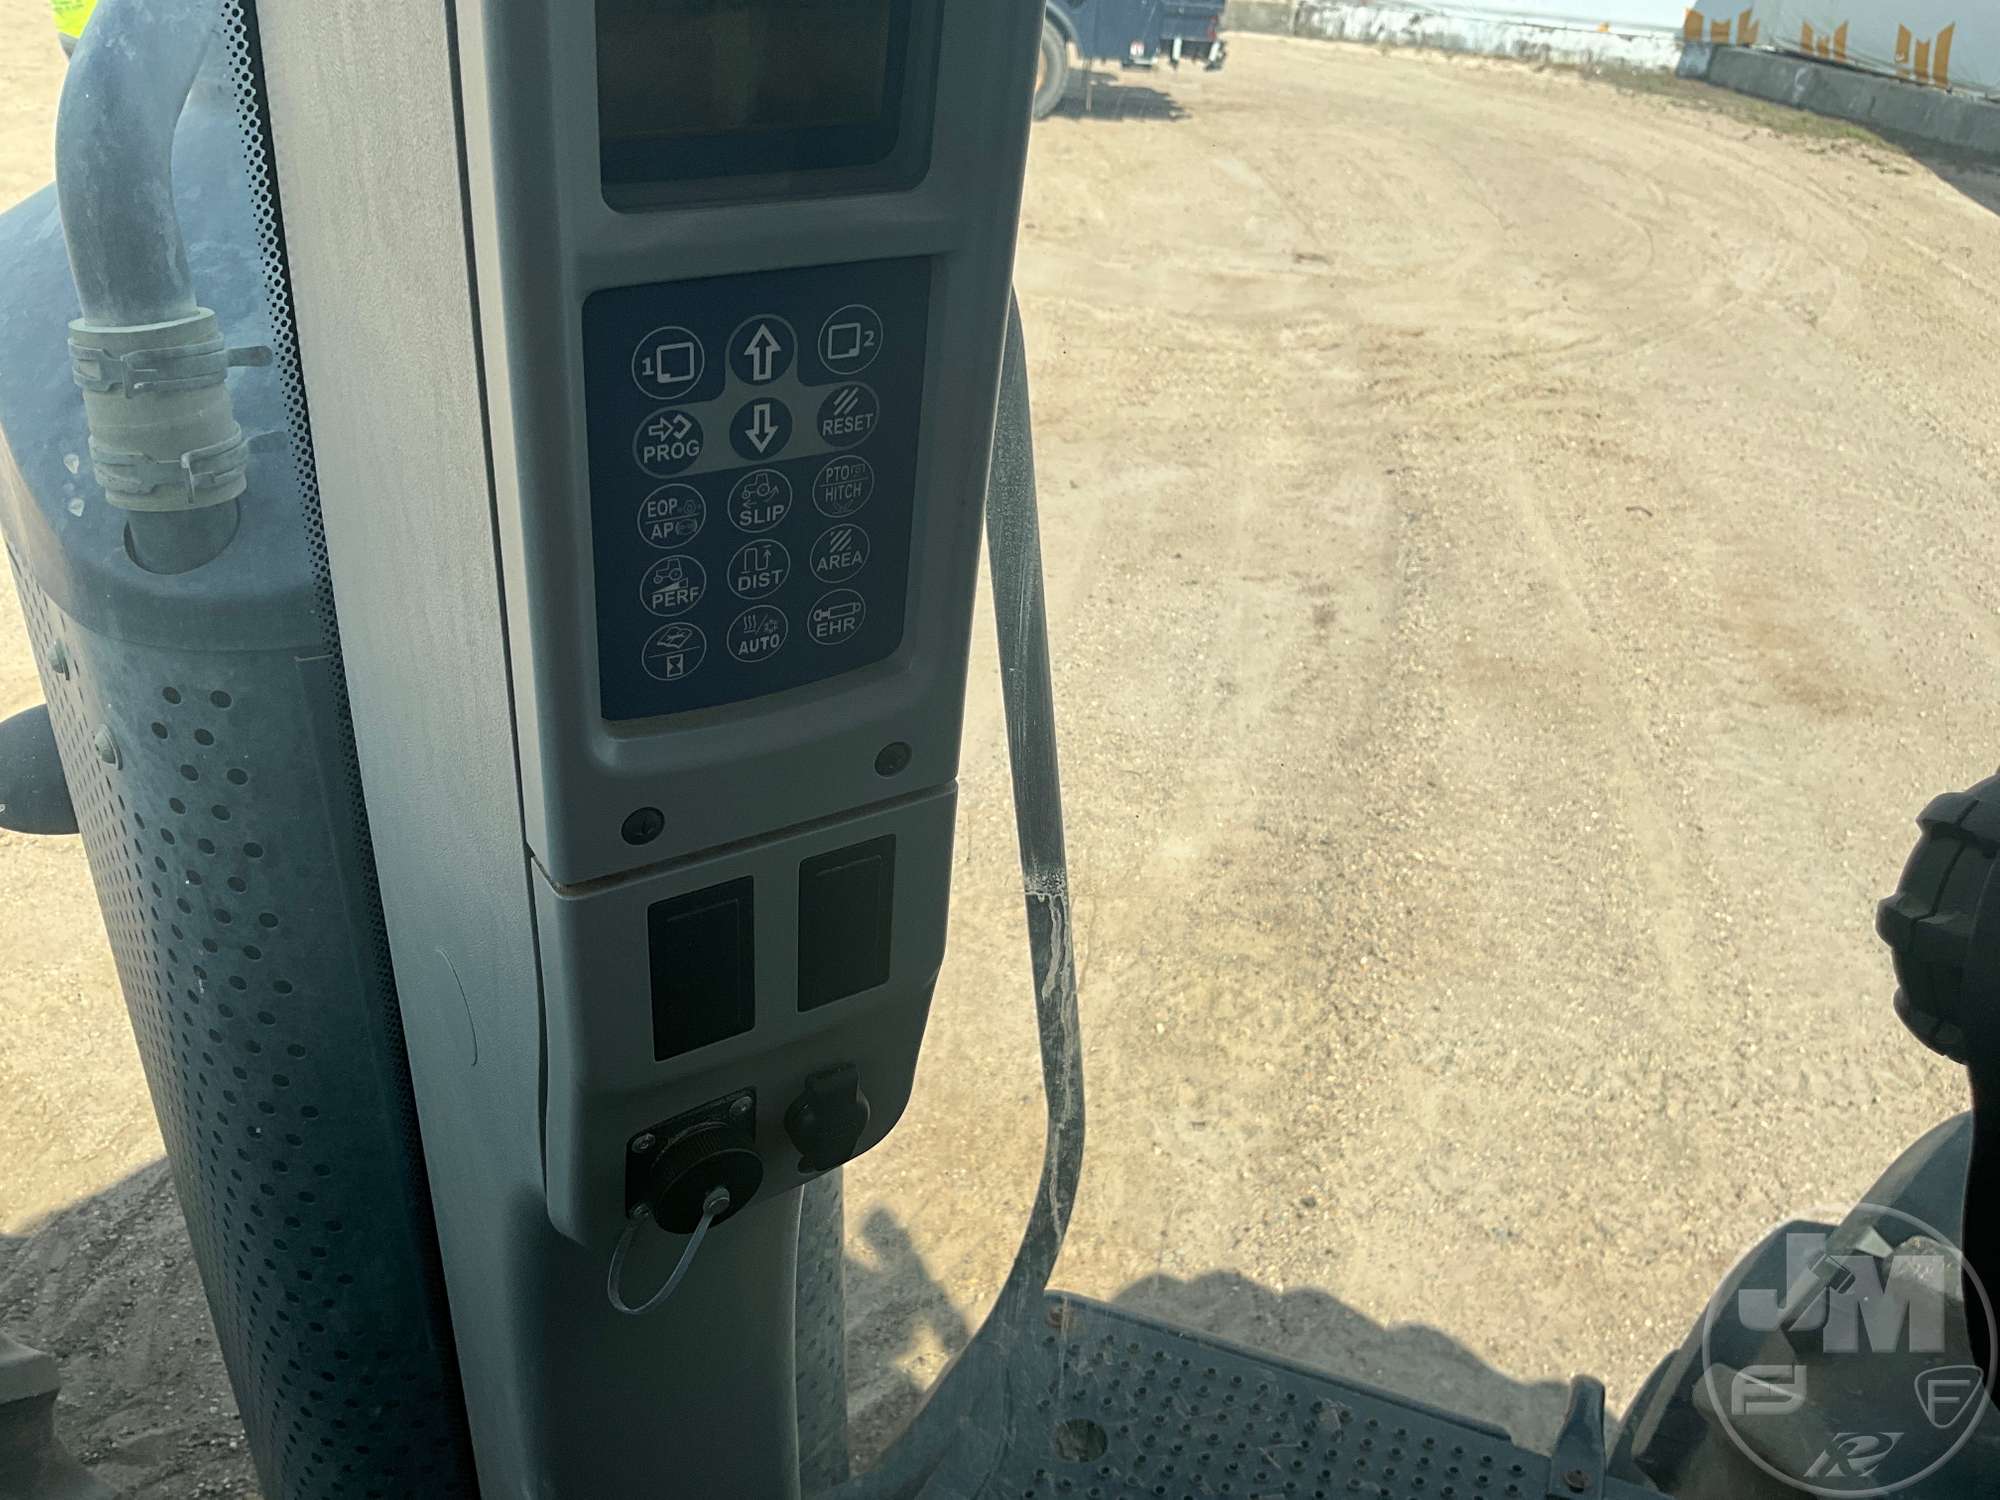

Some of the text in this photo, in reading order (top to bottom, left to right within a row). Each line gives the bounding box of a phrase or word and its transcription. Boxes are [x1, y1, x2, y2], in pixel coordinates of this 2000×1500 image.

[862, 330, 876, 347] 2
[641, 357, 655, 376] 1
[821, 413, 874, 436] RESET
[643, 439, 700, 464] PROG
[825, 465, 850, 483] PTO
[825, 482, 862, 503] HITCH
[647, 498, 677, 518] EOP
[739, 504, 785, 527] SLIP
[650, 522, 674, 541] AP
[815, 548, 863, 573] AREA
[738, 569, 784, 593] DIST
[651, 586, 700, 609] PERF
[815, 616, 856, 638] EHR
[738, 634, 780, 656] AUTO
